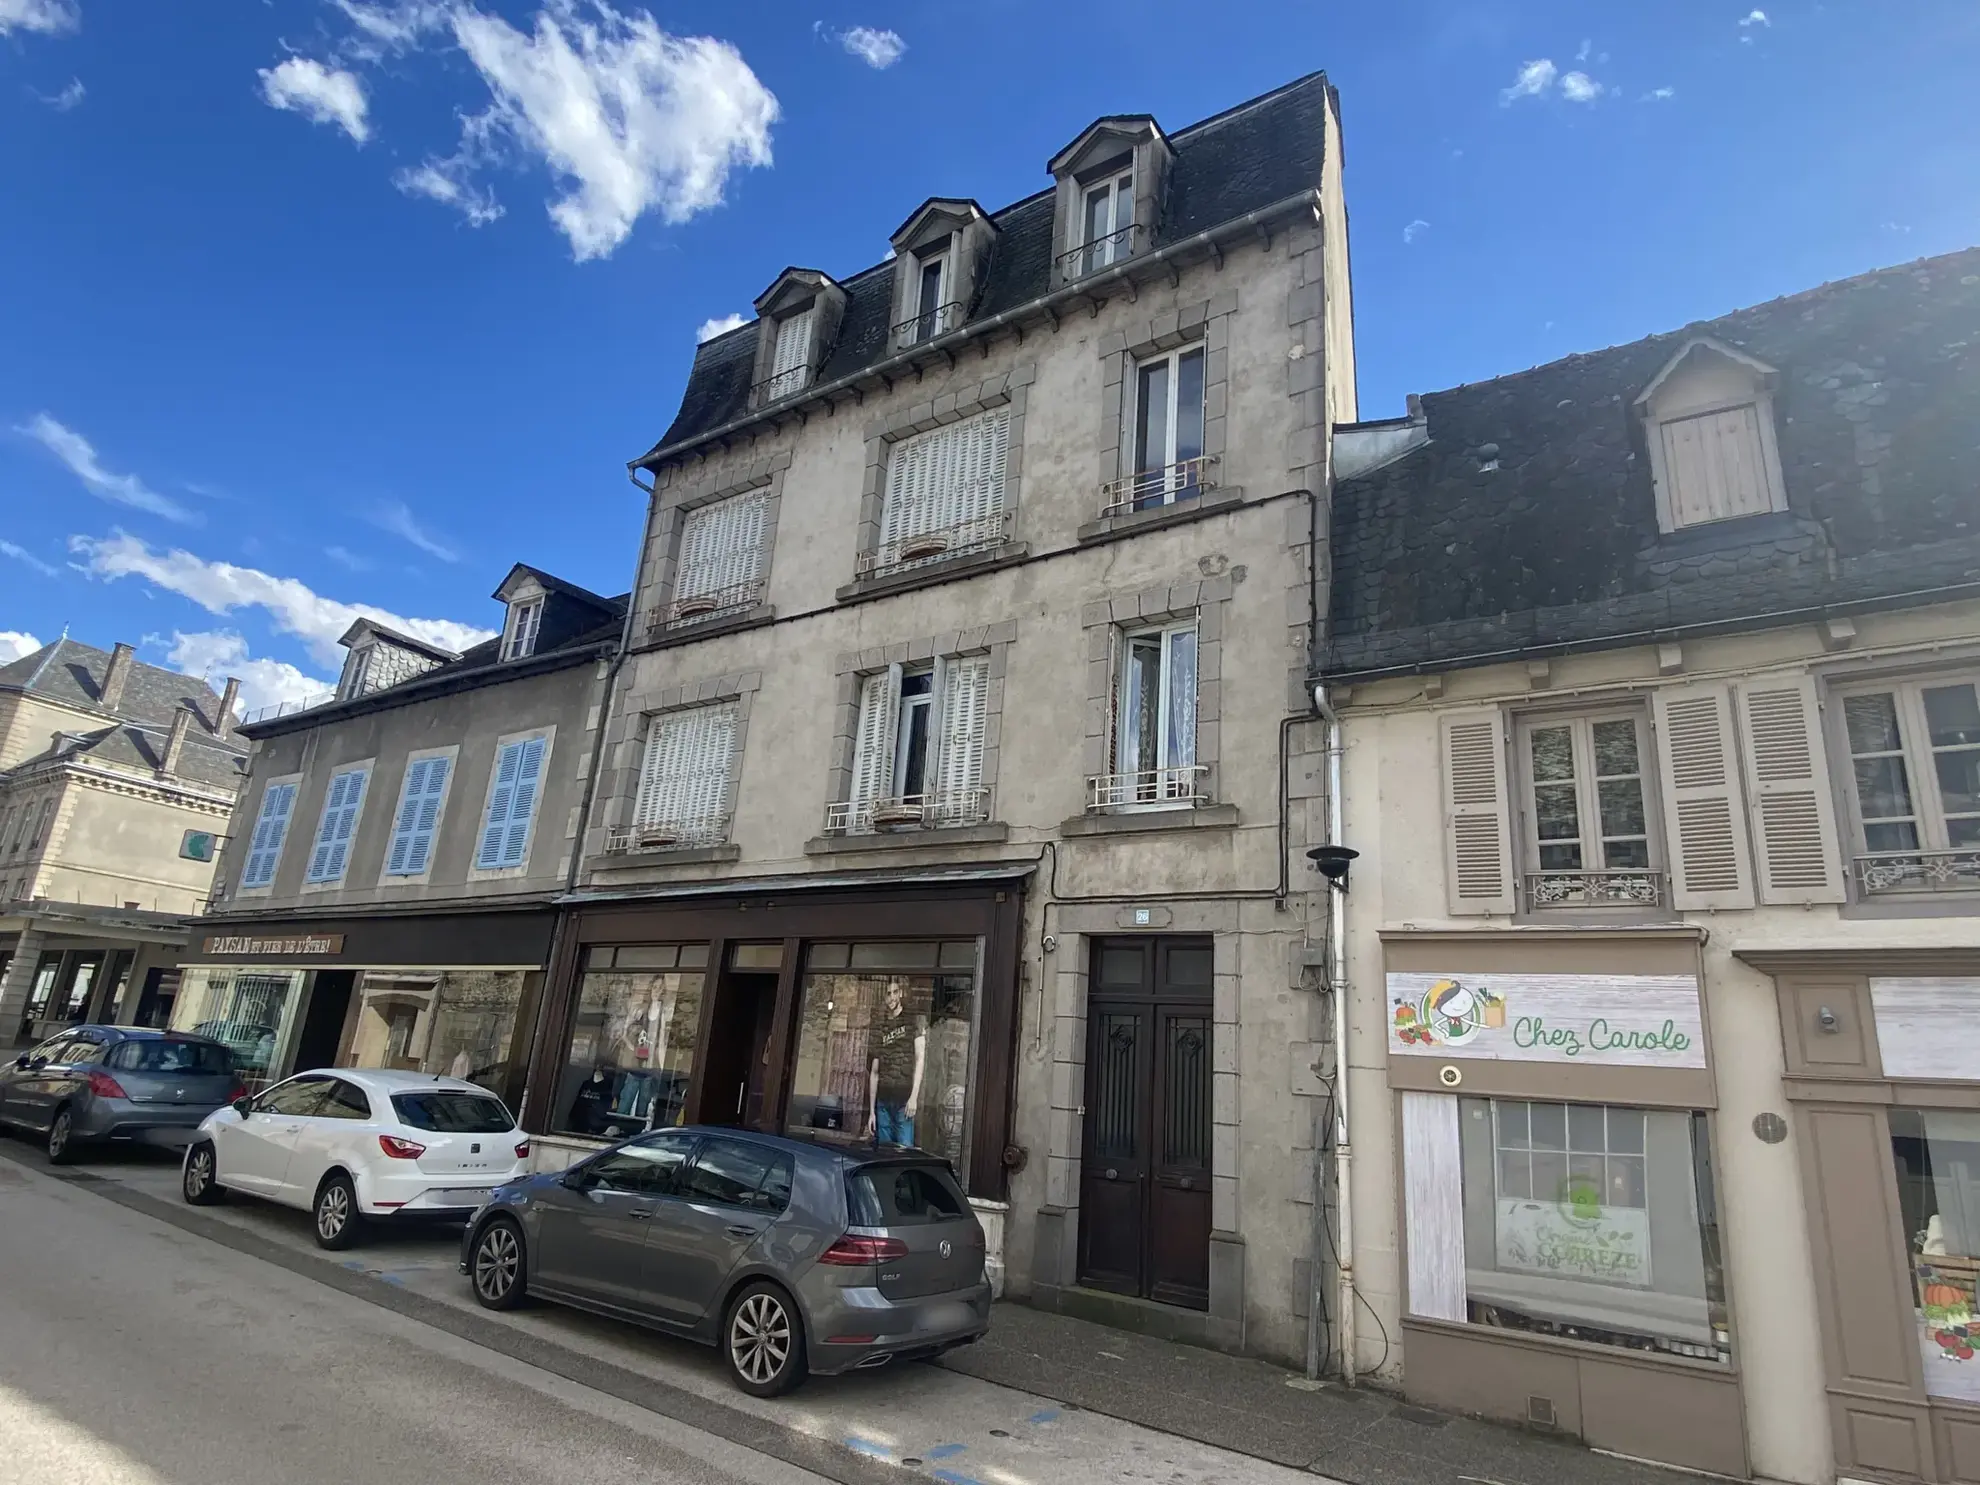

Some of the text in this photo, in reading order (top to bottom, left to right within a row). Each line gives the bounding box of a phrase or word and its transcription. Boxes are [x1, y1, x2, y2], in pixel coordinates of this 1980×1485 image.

[211, 937, 252, 953] PAYSAN
[283, 941, 295, 953] DE
[1513, 1017, 1690, 1056] Chez Carole
